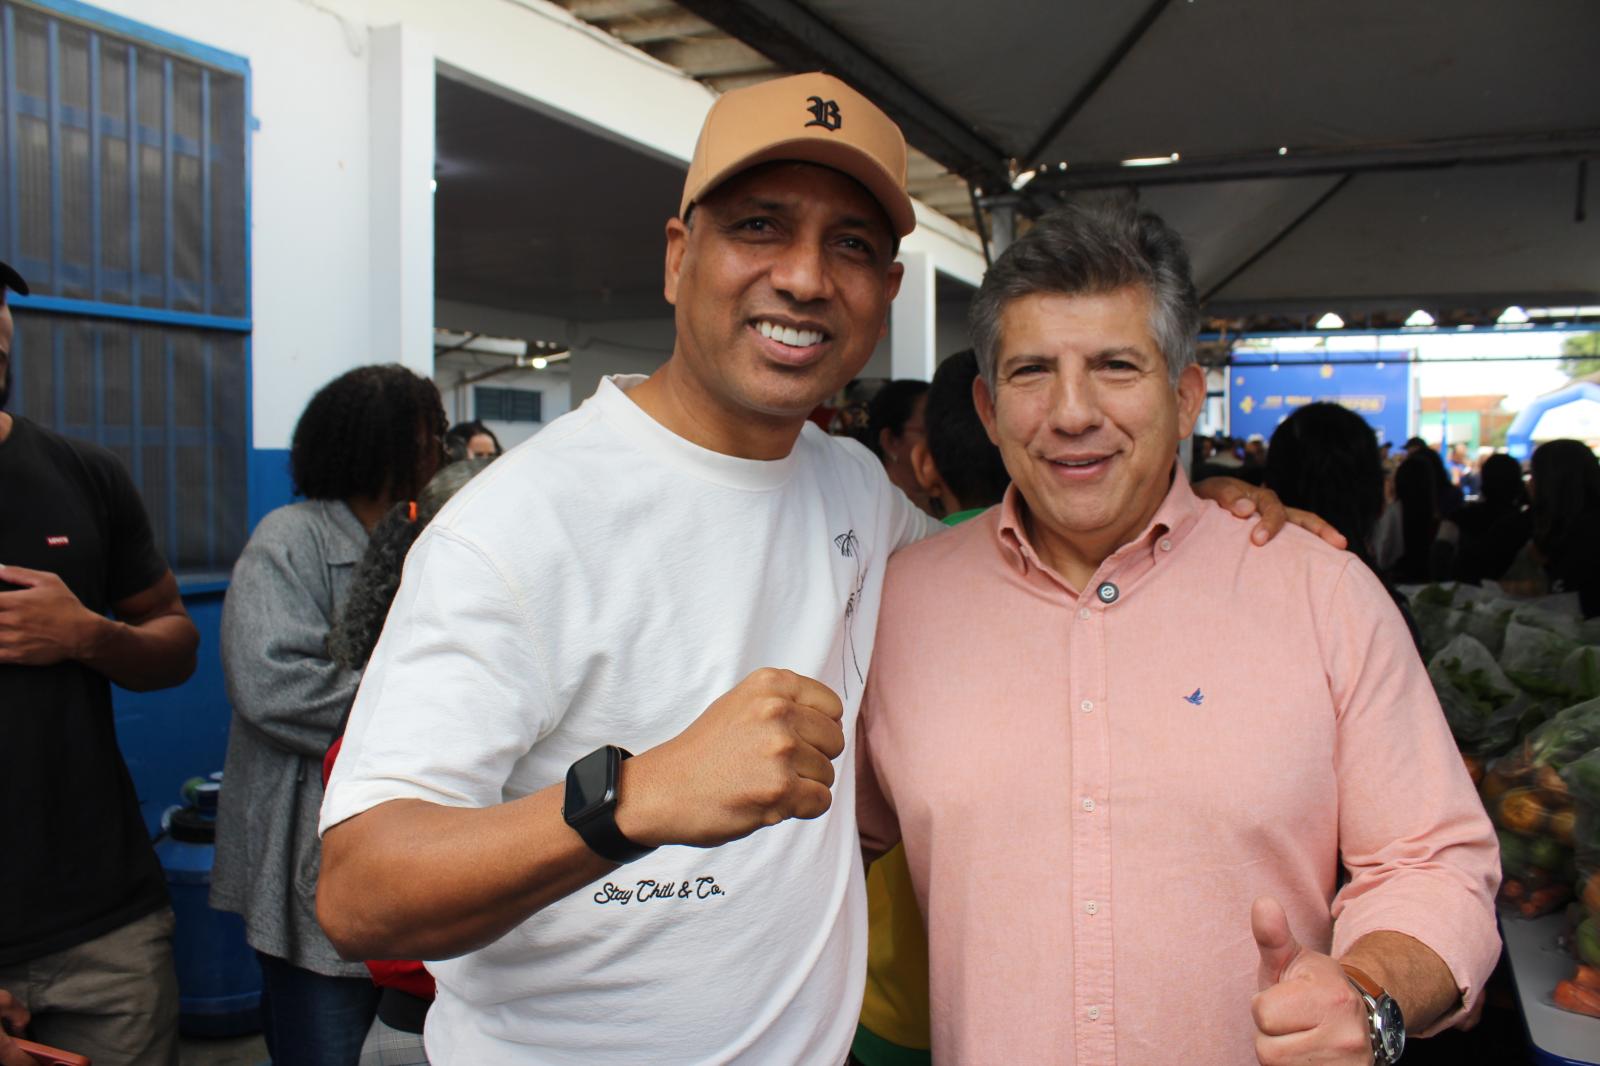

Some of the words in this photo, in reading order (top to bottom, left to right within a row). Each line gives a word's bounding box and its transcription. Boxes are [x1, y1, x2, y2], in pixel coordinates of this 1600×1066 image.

[805, 96, 842, 132] B
[594, 882, 633, 905] Stay
[636, 880, 675, 902] Chill
[678, 880, 692, 899] &
[696, 876, 725, 899] Co.
